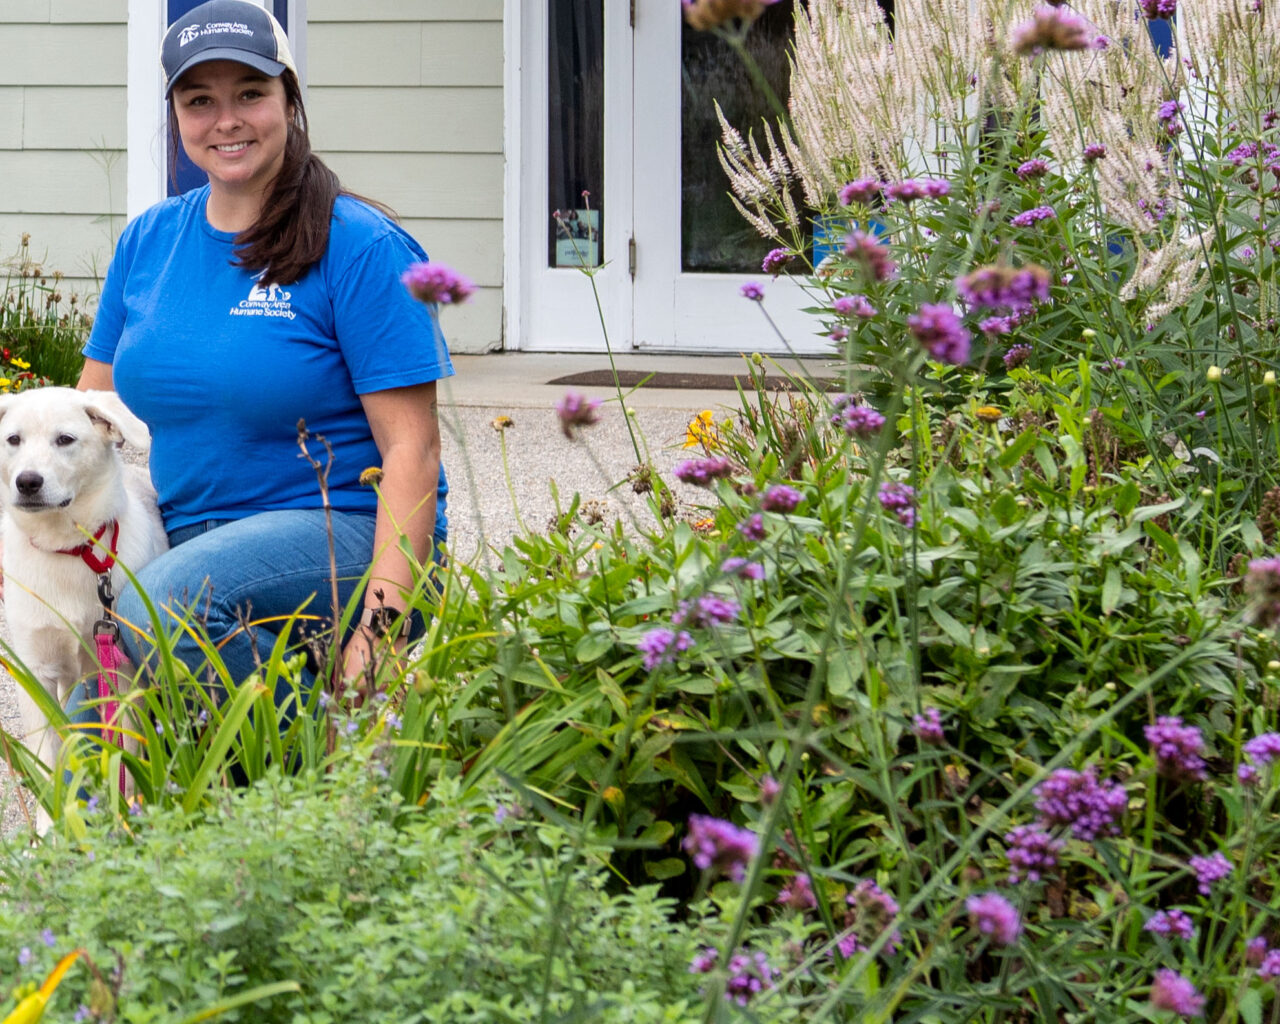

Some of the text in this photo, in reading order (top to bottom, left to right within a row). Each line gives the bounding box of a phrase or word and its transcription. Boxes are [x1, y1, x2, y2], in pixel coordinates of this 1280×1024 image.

[232, 21, 248, 29] Area
[200, 26, 254, 37] Humane Society
[239, 299, 292, 309] Conway Area
[229, 307, 297, 321] Humane Society
